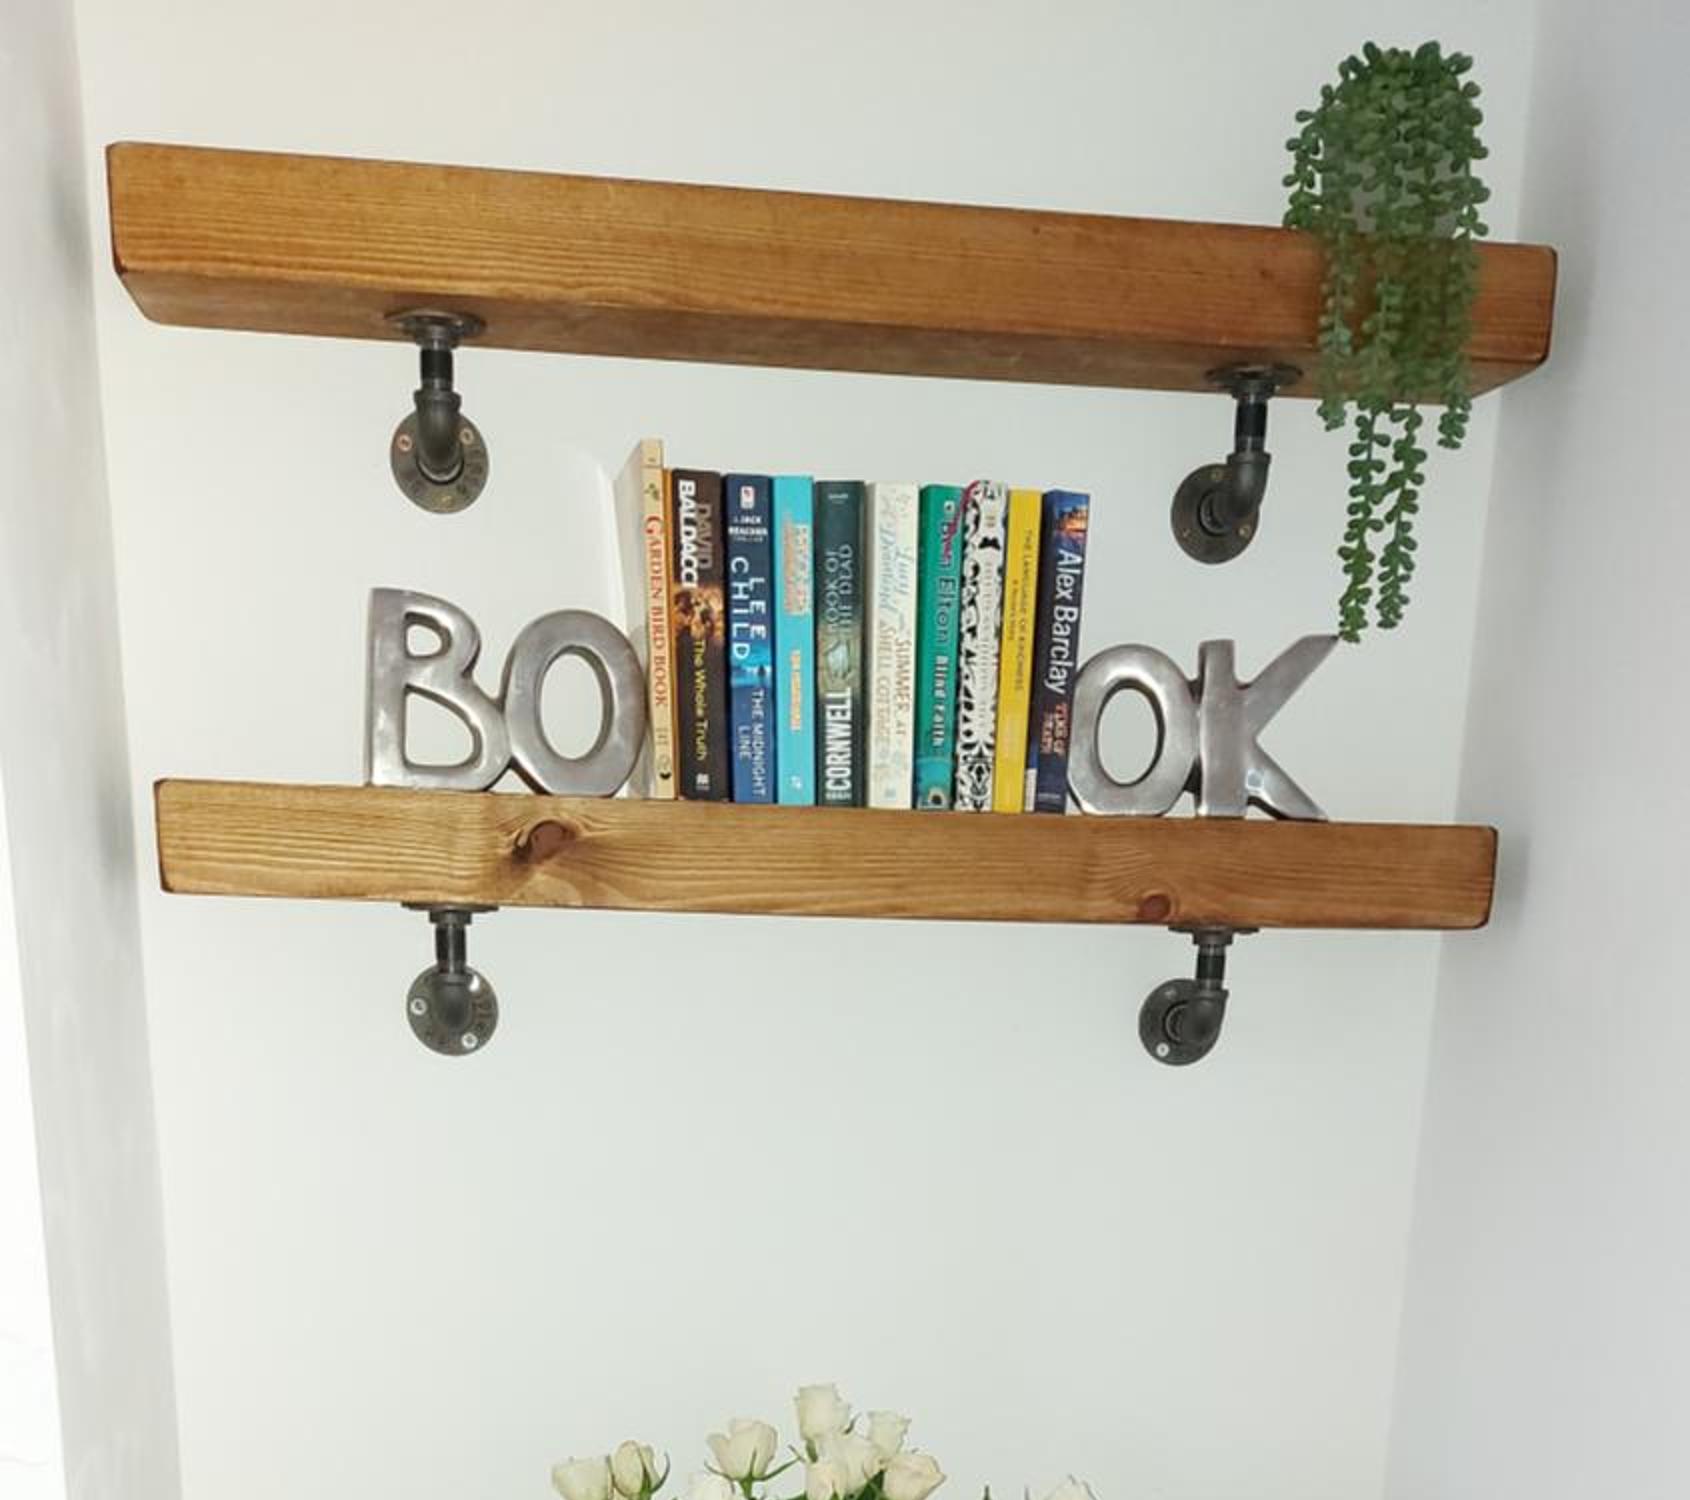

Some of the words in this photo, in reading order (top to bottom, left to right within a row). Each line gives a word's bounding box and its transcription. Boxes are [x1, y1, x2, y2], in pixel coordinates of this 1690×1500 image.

[643, 514, 665, 600] GARDEN
[678, 479, 699, 588] BALDACCI
[697, 502, 713, 570] DAVID
[838, 543, 855, 595] DEAD
[1055, 549, 1085, 599] Alex
[650, 605, 667, 650] BIRD
[731, 556, 751, 660] CHILD
[749, 577, 767, 639] LEE
[933, 577, 957, 646] Elton
[693, 640, 706, 666] The
[933, 655, 950, 698] Blind
[1044, 607, 1079, 695] Barclay
[653, 656, 669, 707] BOOK
[694, 671, 707, 716] Whole
[751, 690, 766, 720] THE
[696, 720, 710, 760] Truth
[737, 724, 752, 760] LINE
[752, 723, 769, 798] MIDNIGHT
[824, 687, 853, 791] CORNWELL
